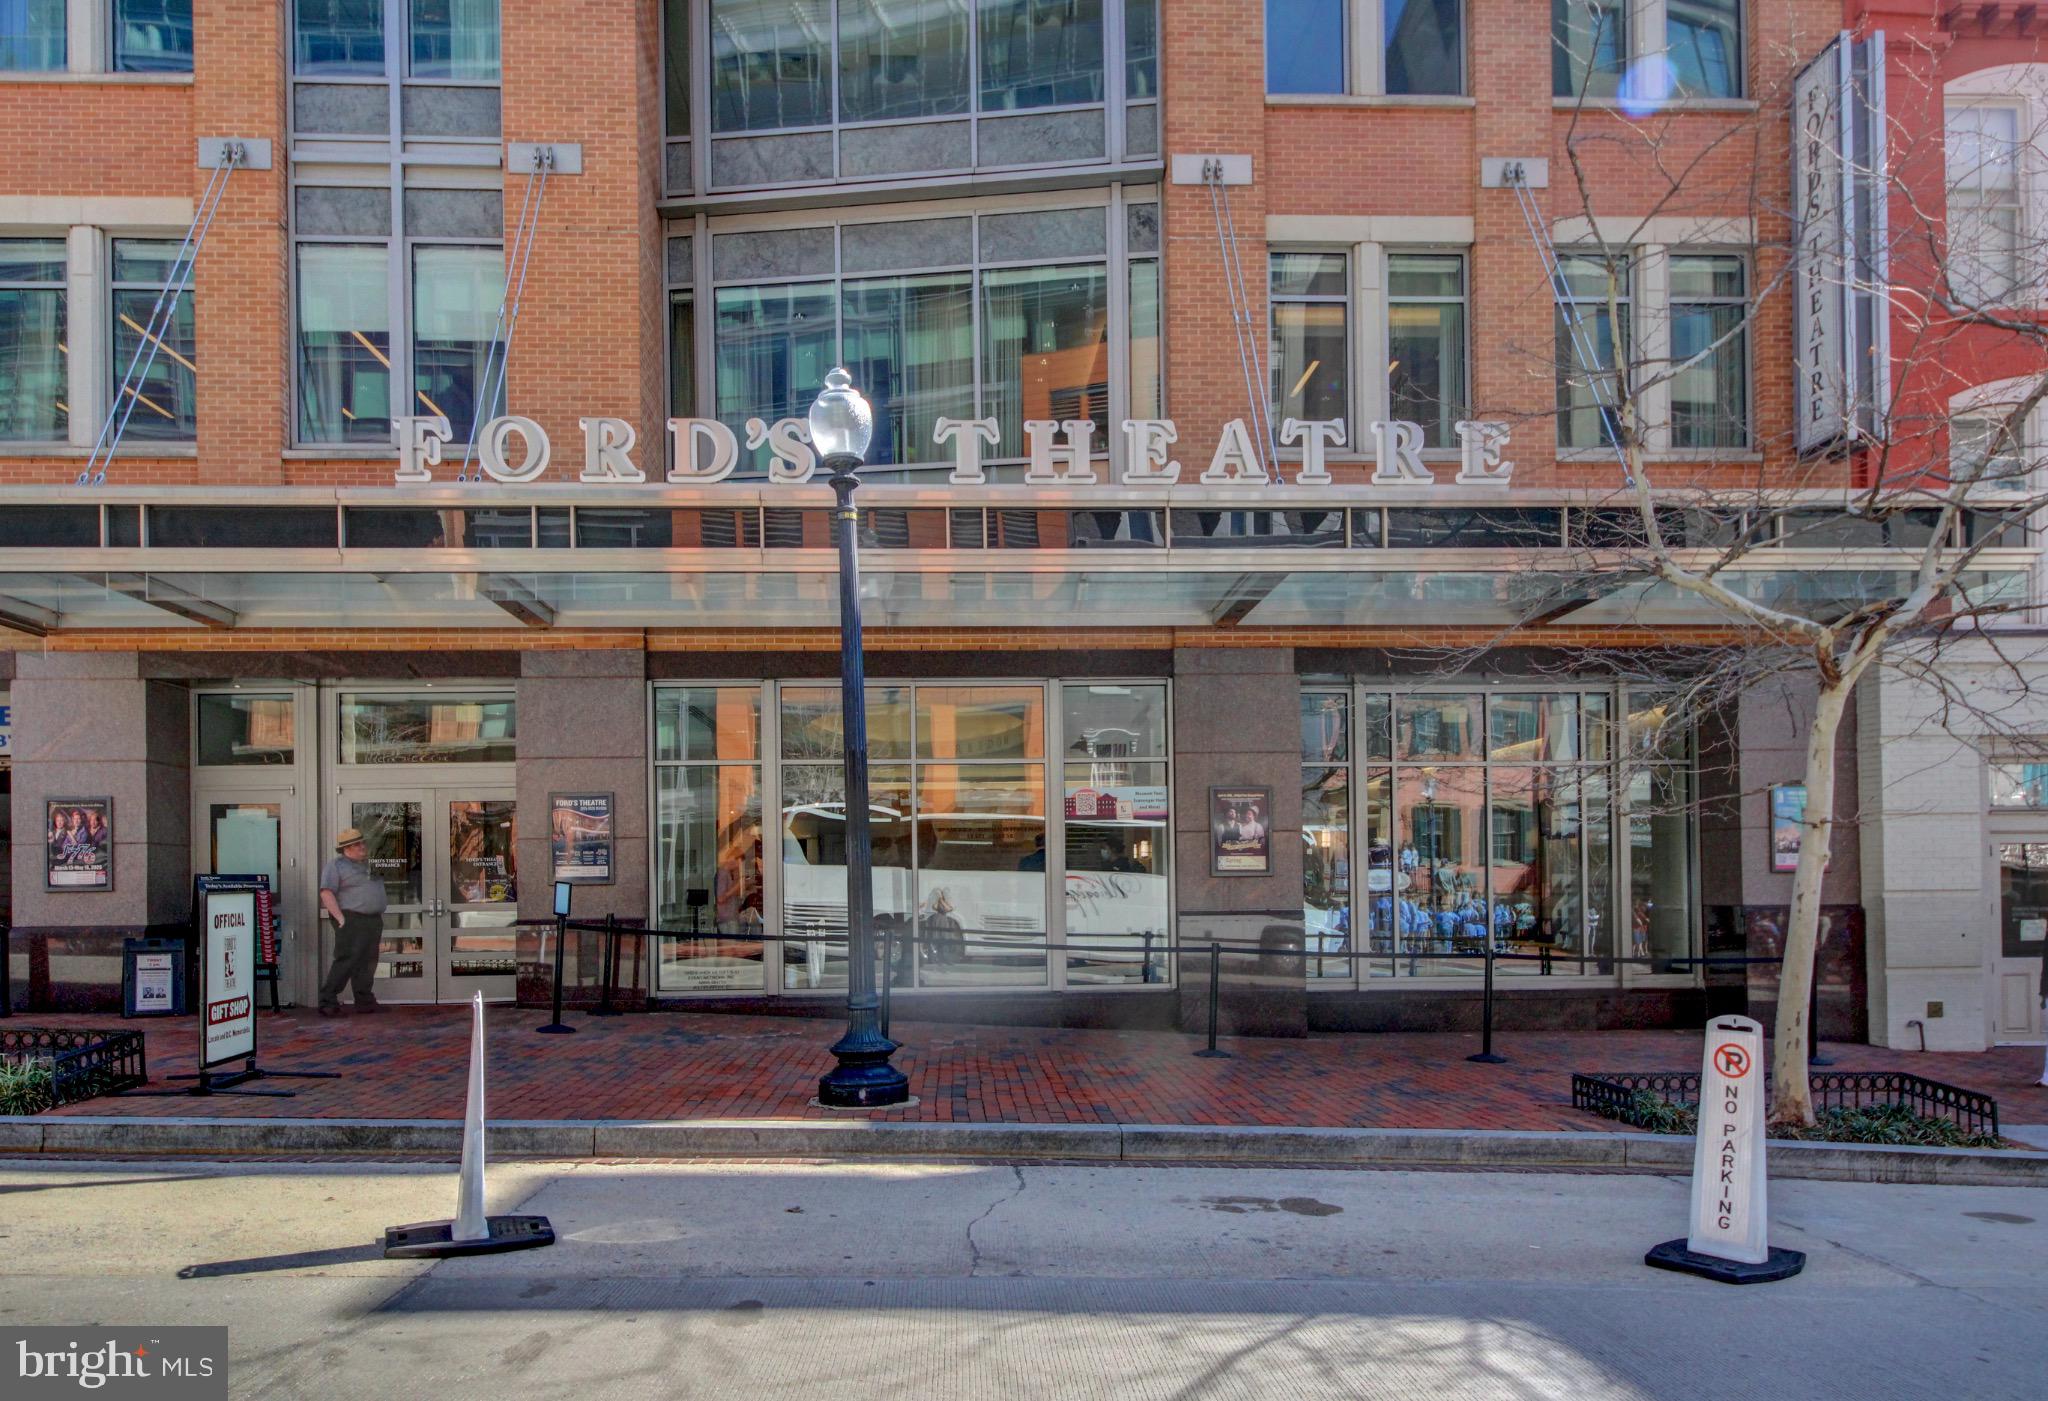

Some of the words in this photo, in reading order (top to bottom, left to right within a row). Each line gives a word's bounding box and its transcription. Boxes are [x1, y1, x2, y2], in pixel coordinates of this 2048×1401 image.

[1806, 231, 1827, 423] THEATRE
[392, 415, 817, 485] FORD'S
[933, 416, 1514, 486] THEATRE
[214, 912, 245, 930] OFFICIAL
[211, 1002, 228, 1022] GIFT
[229, 998, 249, 1017] SHOP
[1724, 1085, 1738, 1115] NO
[1718, 1124, 1737, 1229] PARKING
